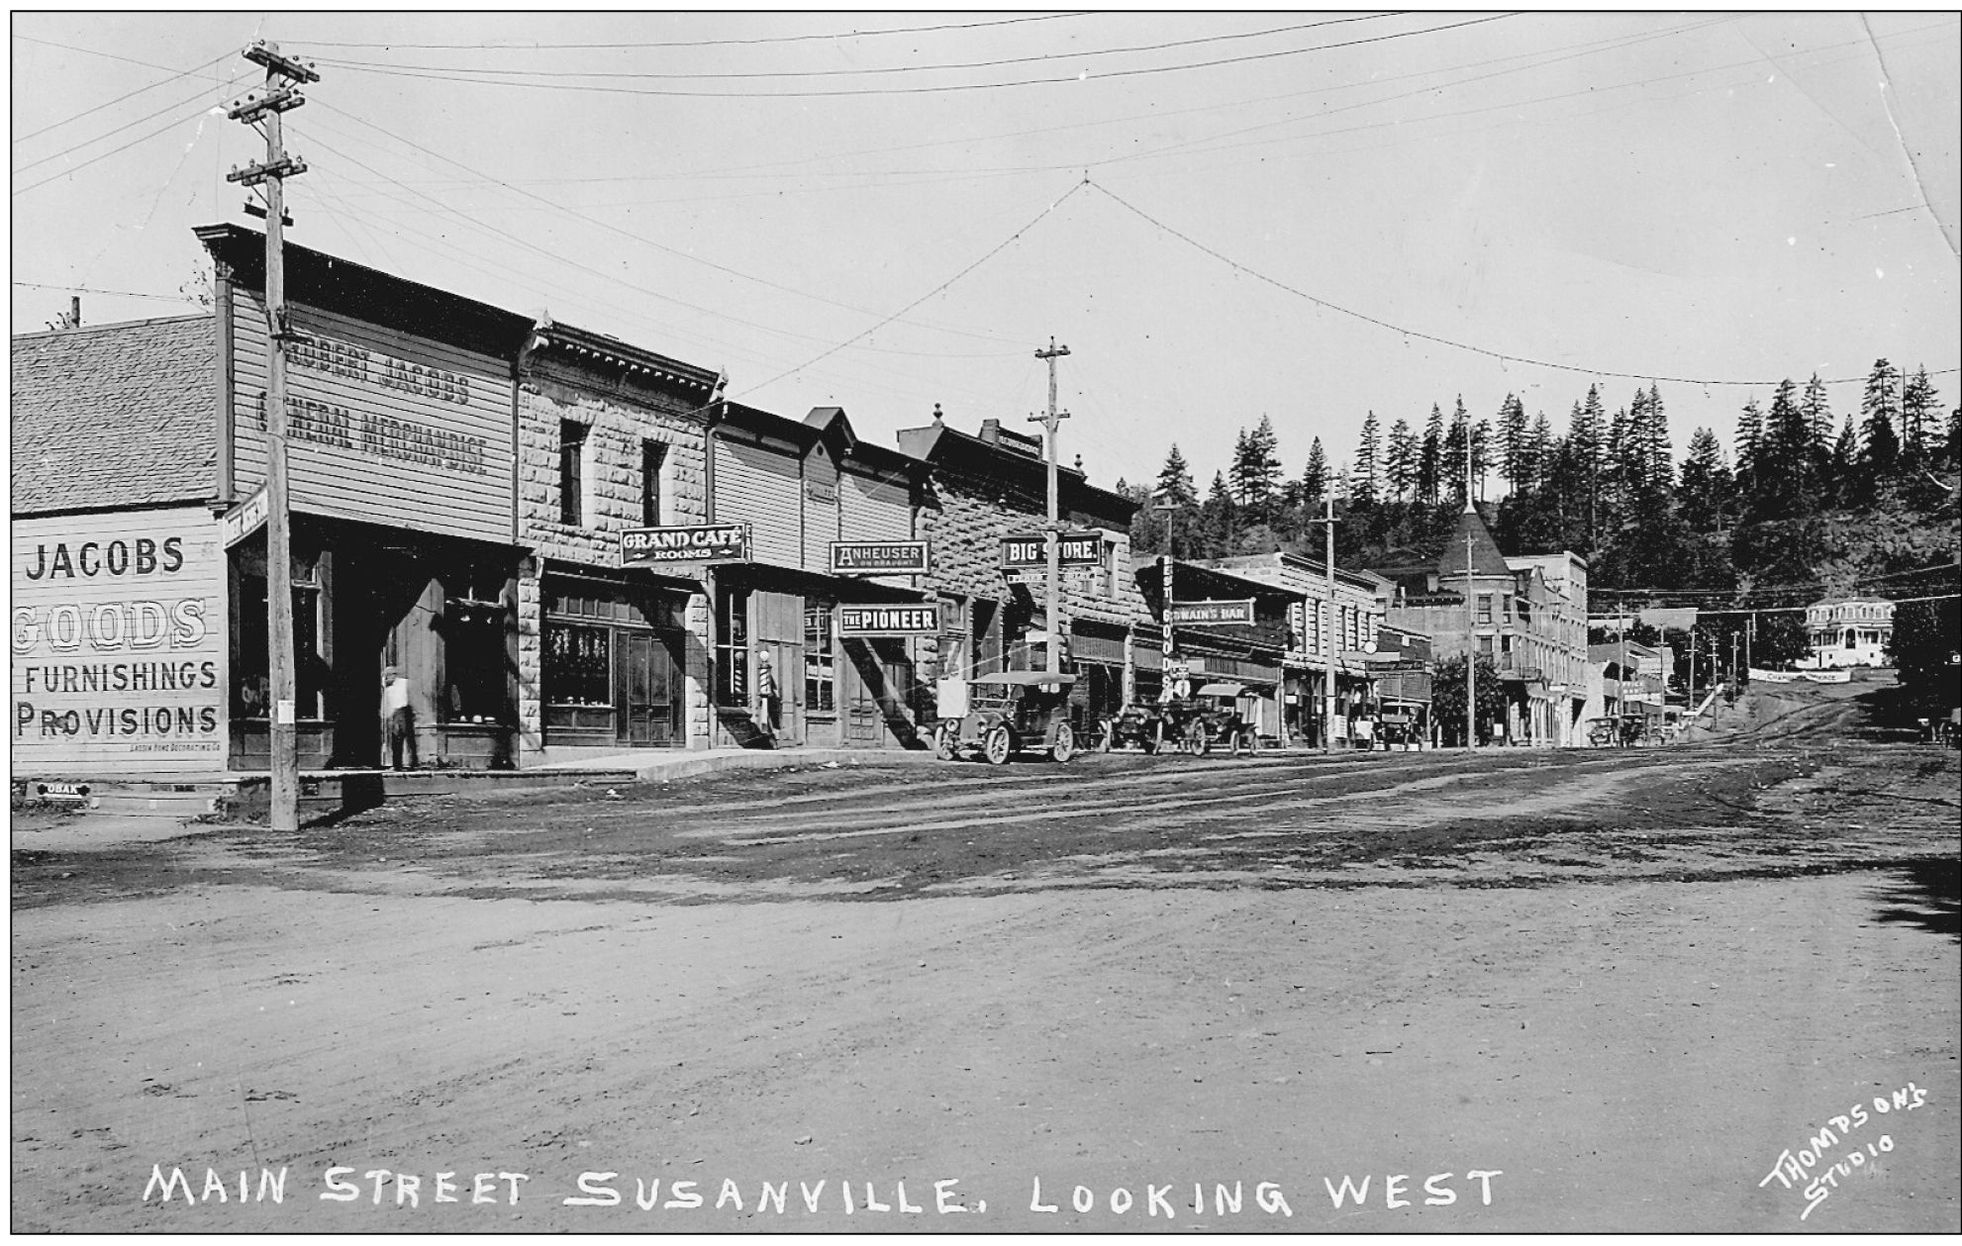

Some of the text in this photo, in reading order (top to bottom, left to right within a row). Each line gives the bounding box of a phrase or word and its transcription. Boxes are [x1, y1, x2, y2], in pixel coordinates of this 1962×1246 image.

[379, 357, 469, 406] JACOBS
[258, 389, 487, 476] GNERAL MERCHANDISE
[623, 531, 690, 549] GRAND
[26, 537, 184, 580] JACOBS
[654, 548, 712, 559] ROOMS
[838, 547, 920, 566] ANHEUSER
[1009, 543, 1038, 562] BIG
[843, 611, 934, 629] THE PIONEER
[1221, 607, 1244, 619] BAR
[12, 598, 207, 655] GOODS
[26, 661, 216, 693] FURNISHINGS
[17, 701, 217, 736] PROVISIONS
[47, 784, 78, 795] OBAK
